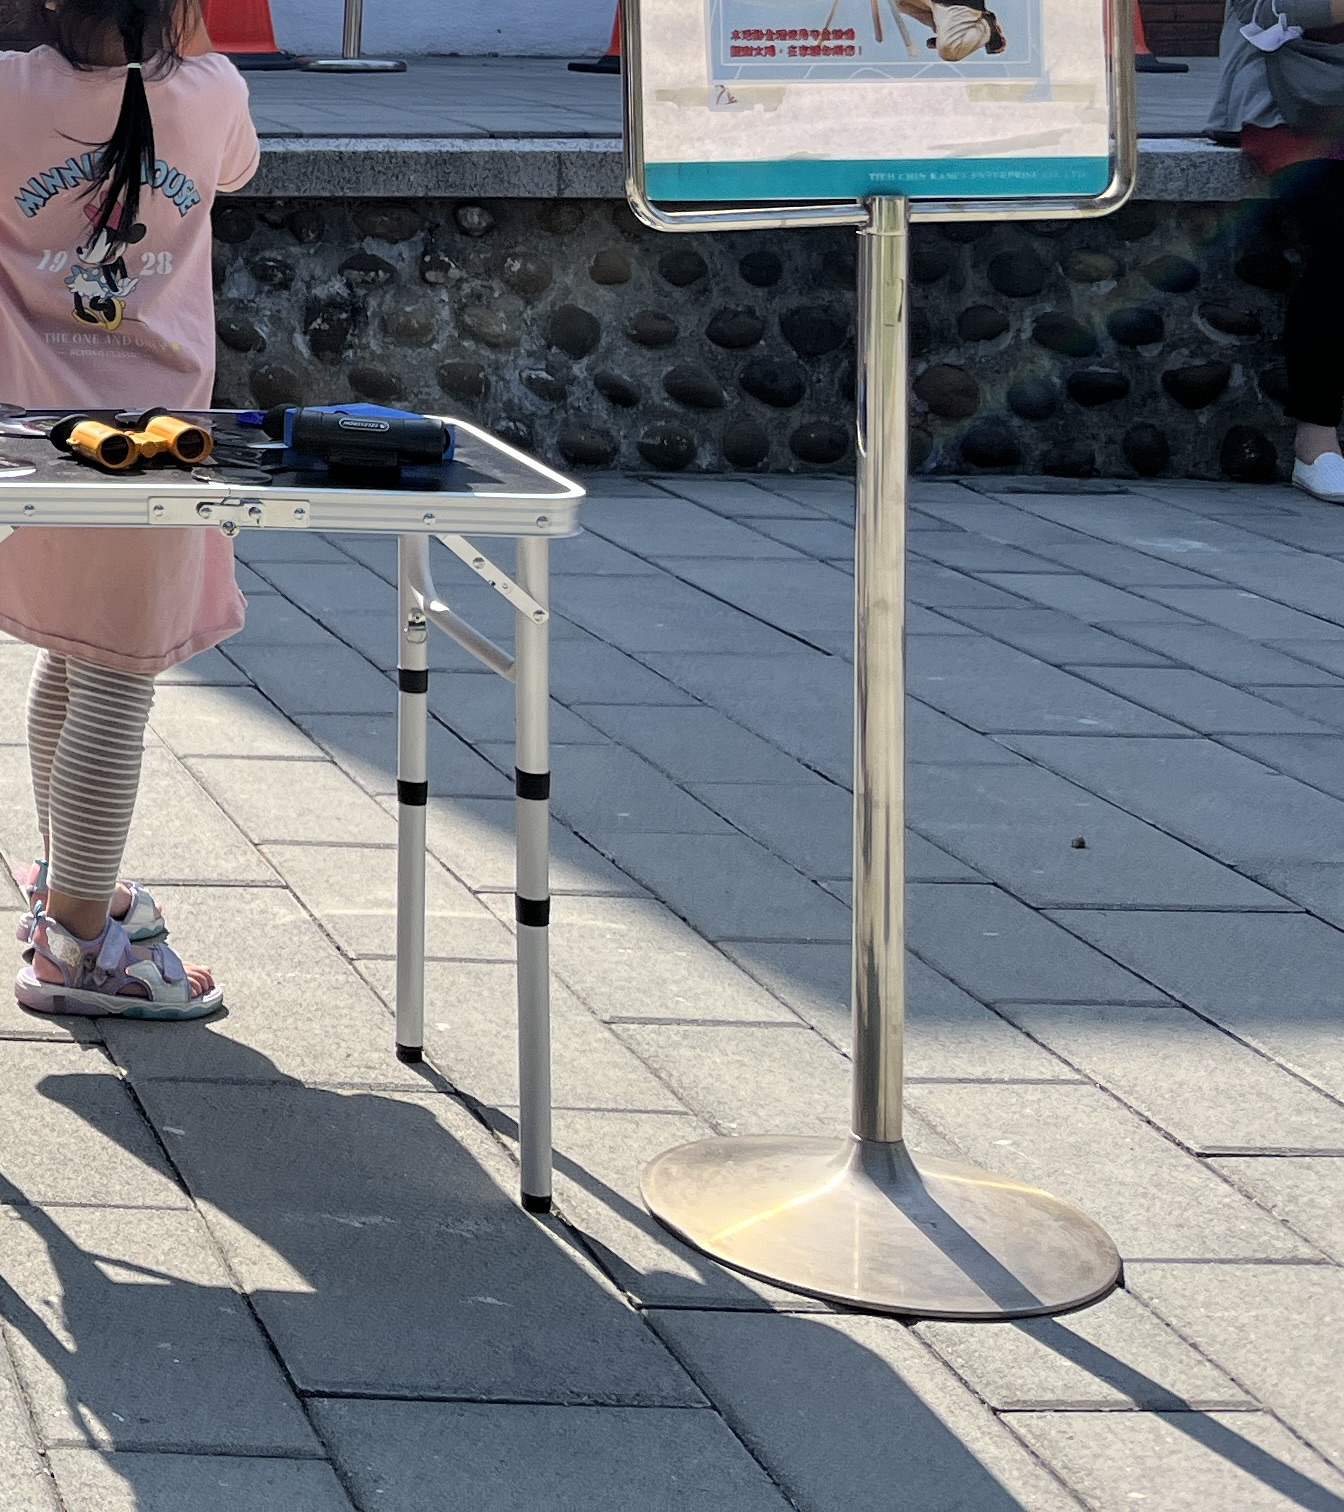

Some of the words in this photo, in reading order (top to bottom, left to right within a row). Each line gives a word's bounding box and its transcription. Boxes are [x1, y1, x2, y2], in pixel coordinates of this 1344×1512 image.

[36, 249, 69, 273] 19
[139, 250, 173, 276] 28
[43, 333, 69, 344] THE
[72, 333, 100, 345] ONE
[104, 335, 131, 346] AND
